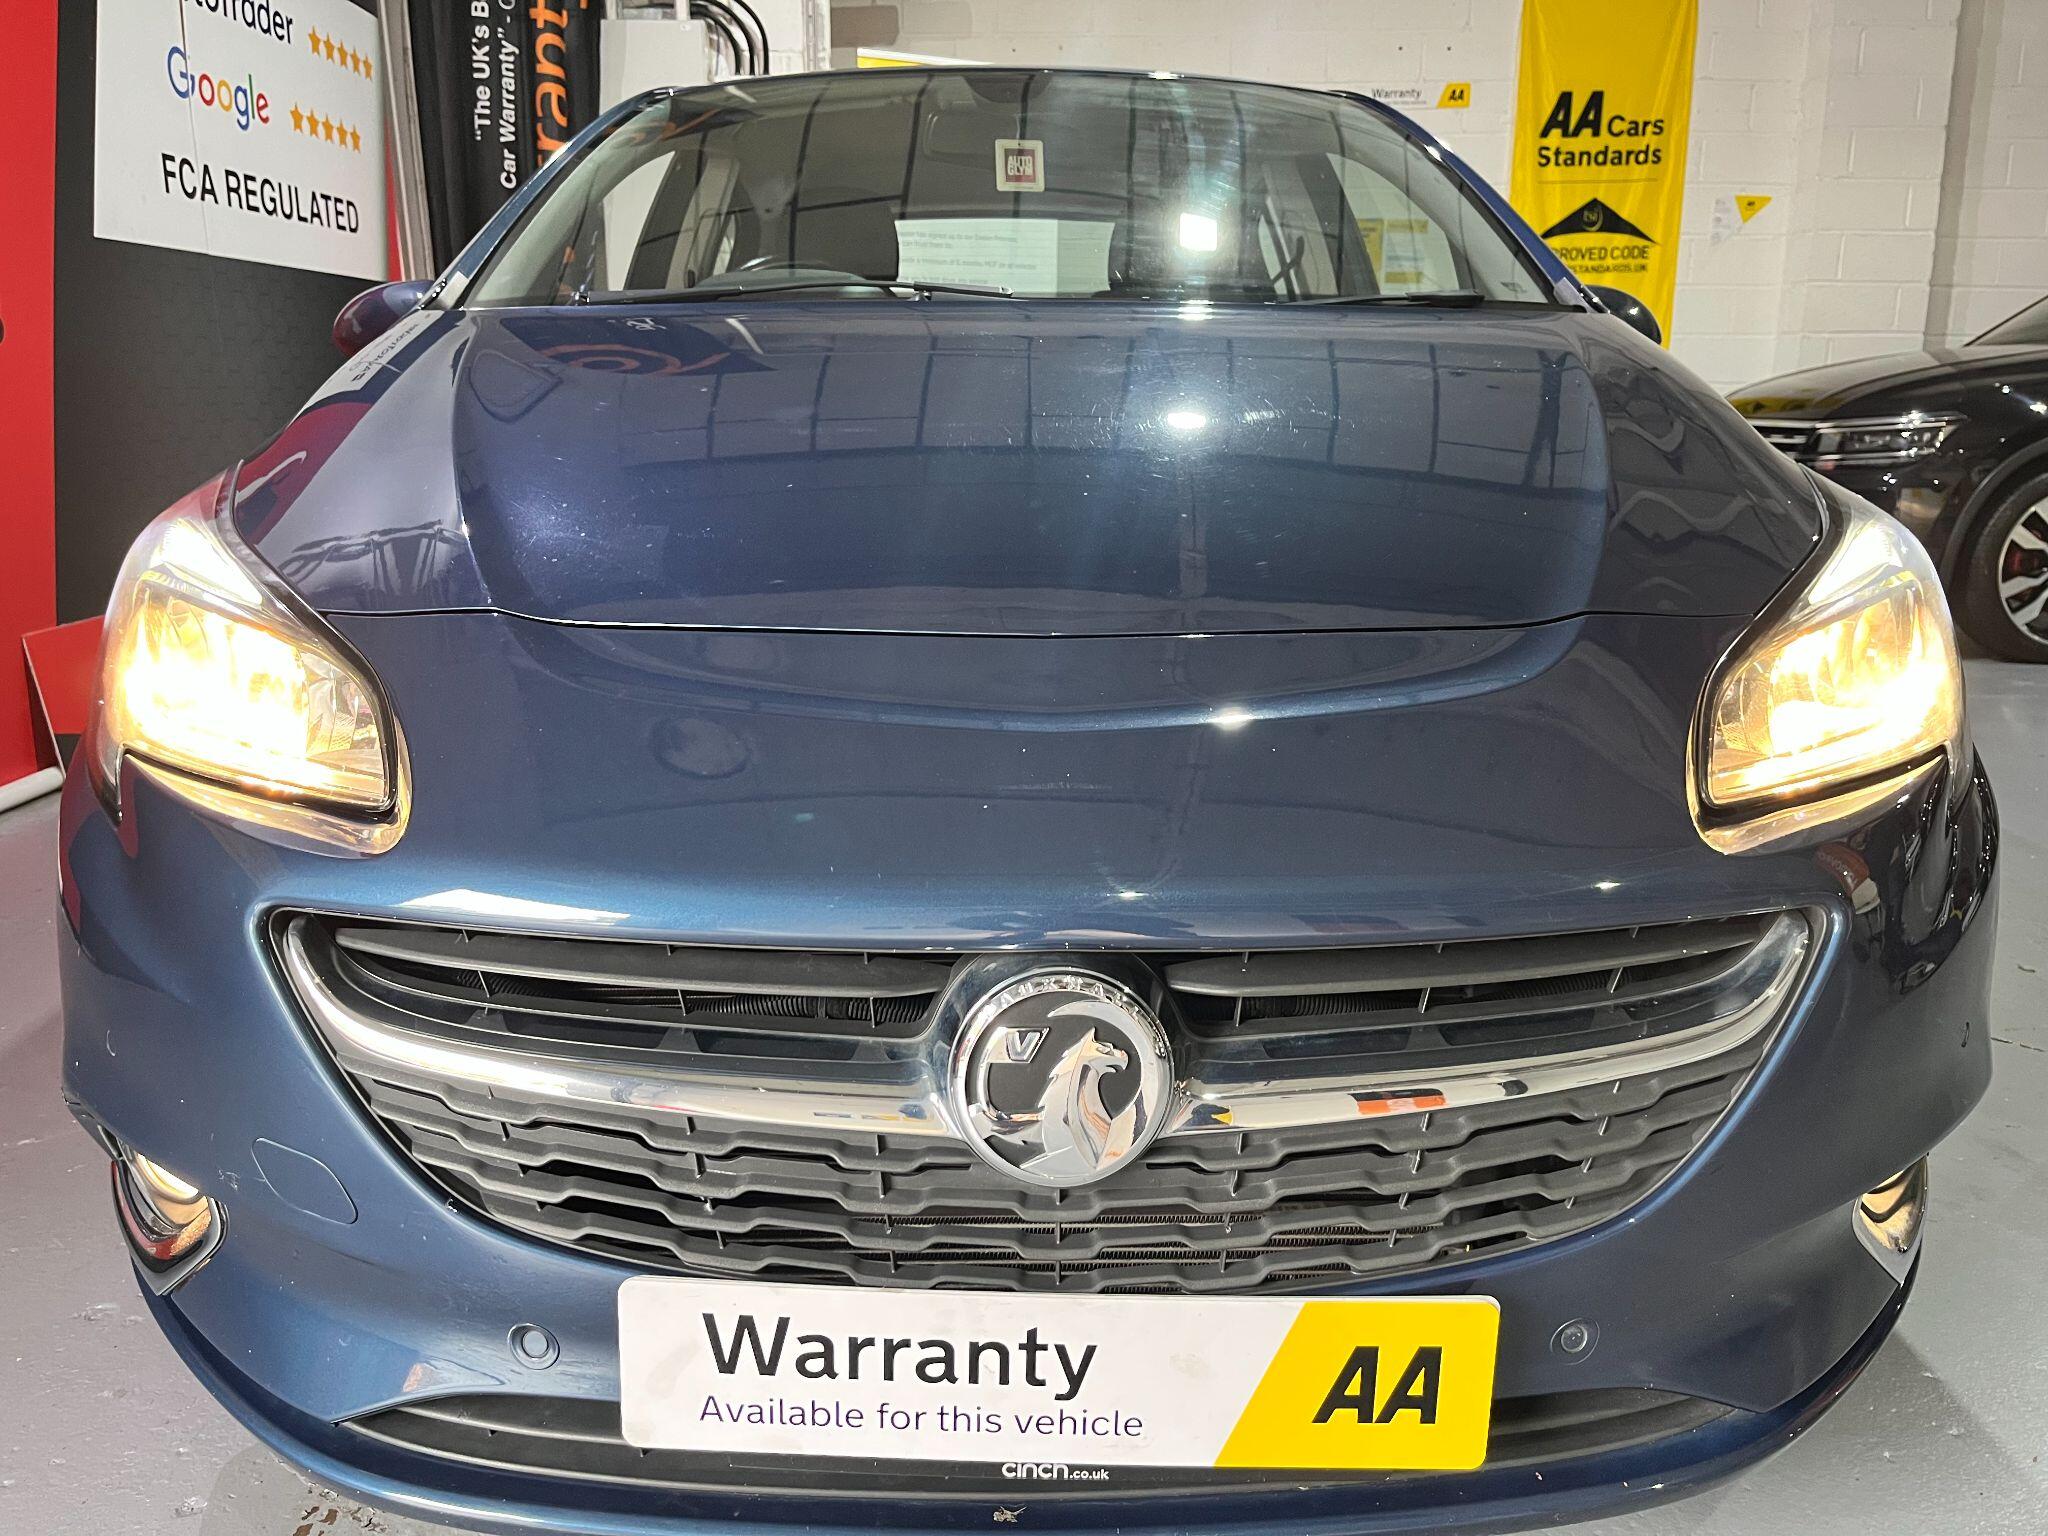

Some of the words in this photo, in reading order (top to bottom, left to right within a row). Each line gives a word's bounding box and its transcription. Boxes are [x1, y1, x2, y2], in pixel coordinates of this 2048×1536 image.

[167, 46, 270, 131] Google
[528, 0, 589, 168] rant
[1372, 89, 1422, 100] Warranty
[1449, 89, 1465, 101] AA
[1540, 90, 1604, 138] AA
[1607, 114, 1664, 137] Cars
[500, 148, 517, 189] Car
[1538, 143, 1661, 167] Standards
[161, 152, 219, 205] FCA
[224, 168, 360, 233] REGULATED
[1610, 244, 1649, 260] CODE
[702, 1312, 1098, 1401] Warranty
[1311, 1345, 1443, 1425] AA
[699, 1395, 864, 1428] Available
[876, 1402, 928, 1430] for
[937, 1405, 1002, 1433] this
[1014, 1408, 1143, 1437] vehicle
